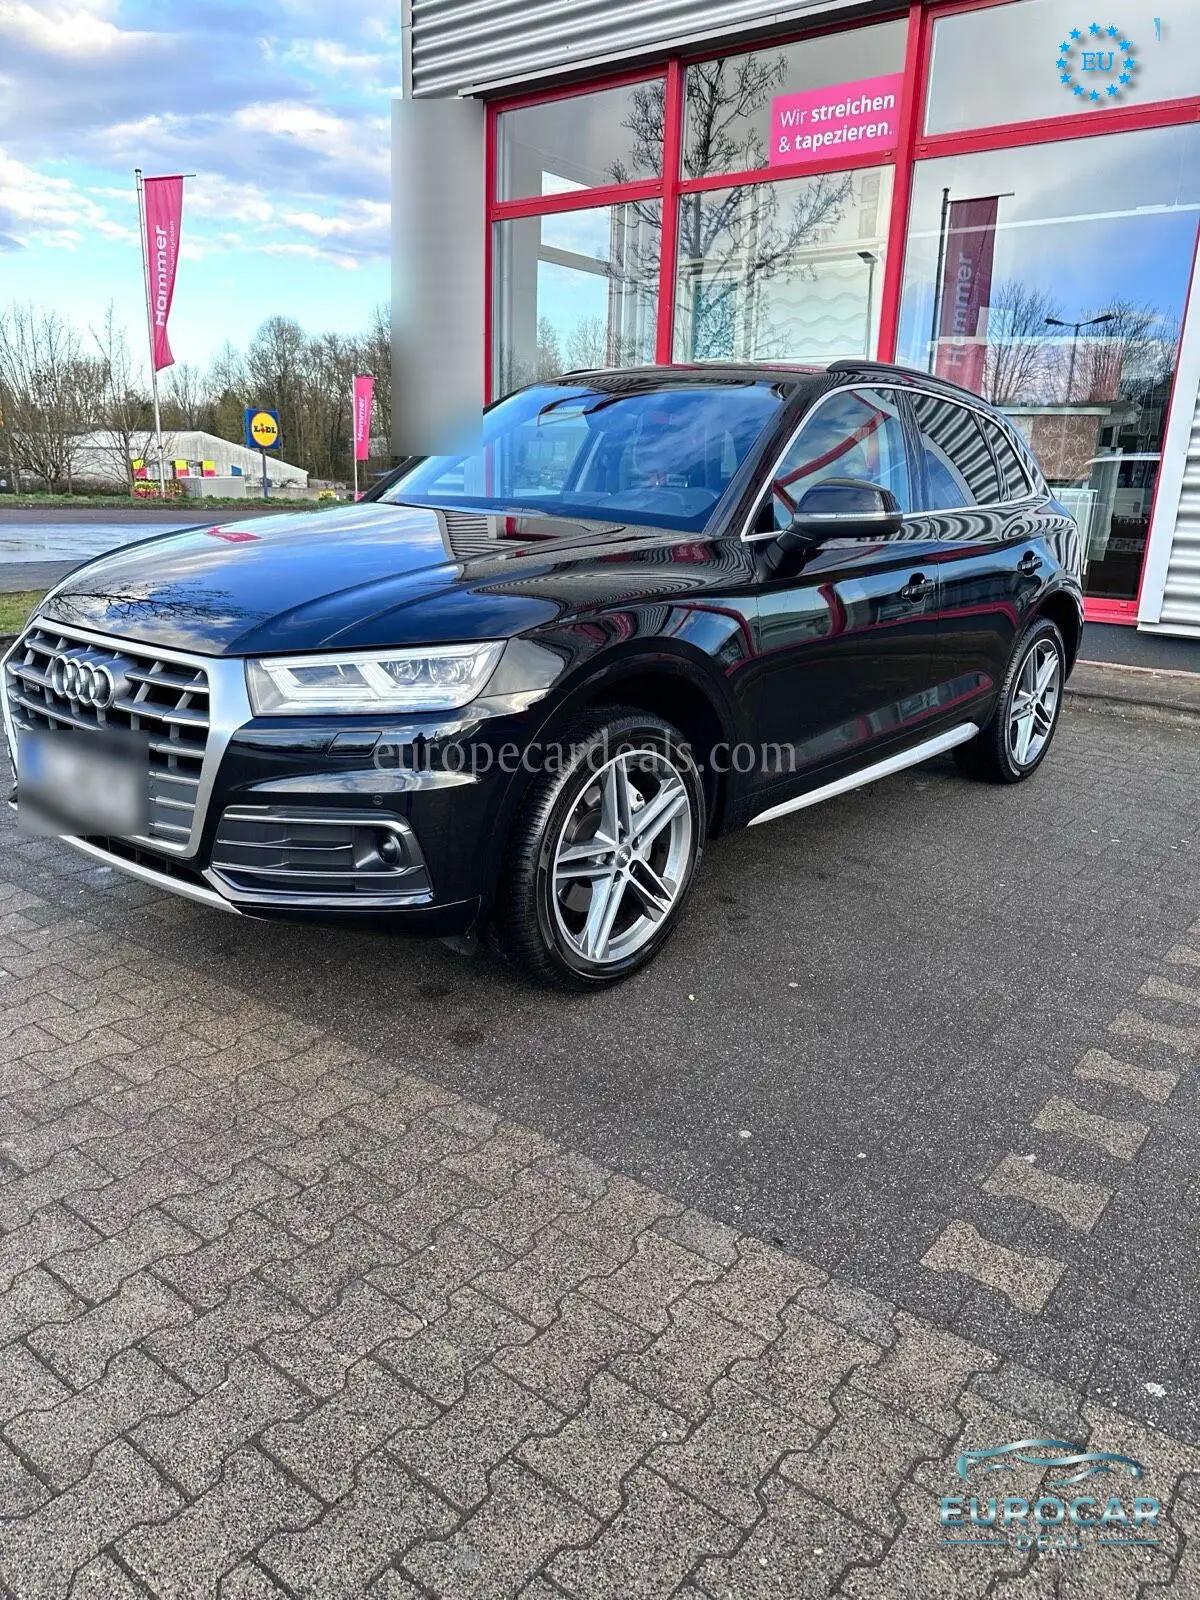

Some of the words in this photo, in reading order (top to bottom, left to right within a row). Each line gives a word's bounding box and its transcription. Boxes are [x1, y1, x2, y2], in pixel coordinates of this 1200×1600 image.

[780, 109, 808, 128] Wir
[810, 94, 895, 122] streichen
[778, 135, 791, 153] &
[795, 121, 893, 152] tapezieren.
[155, 225, 167, 327] Hammer
[944, 252, 973, 367] Hammer
[357, 396, 365, 441] Hammer
